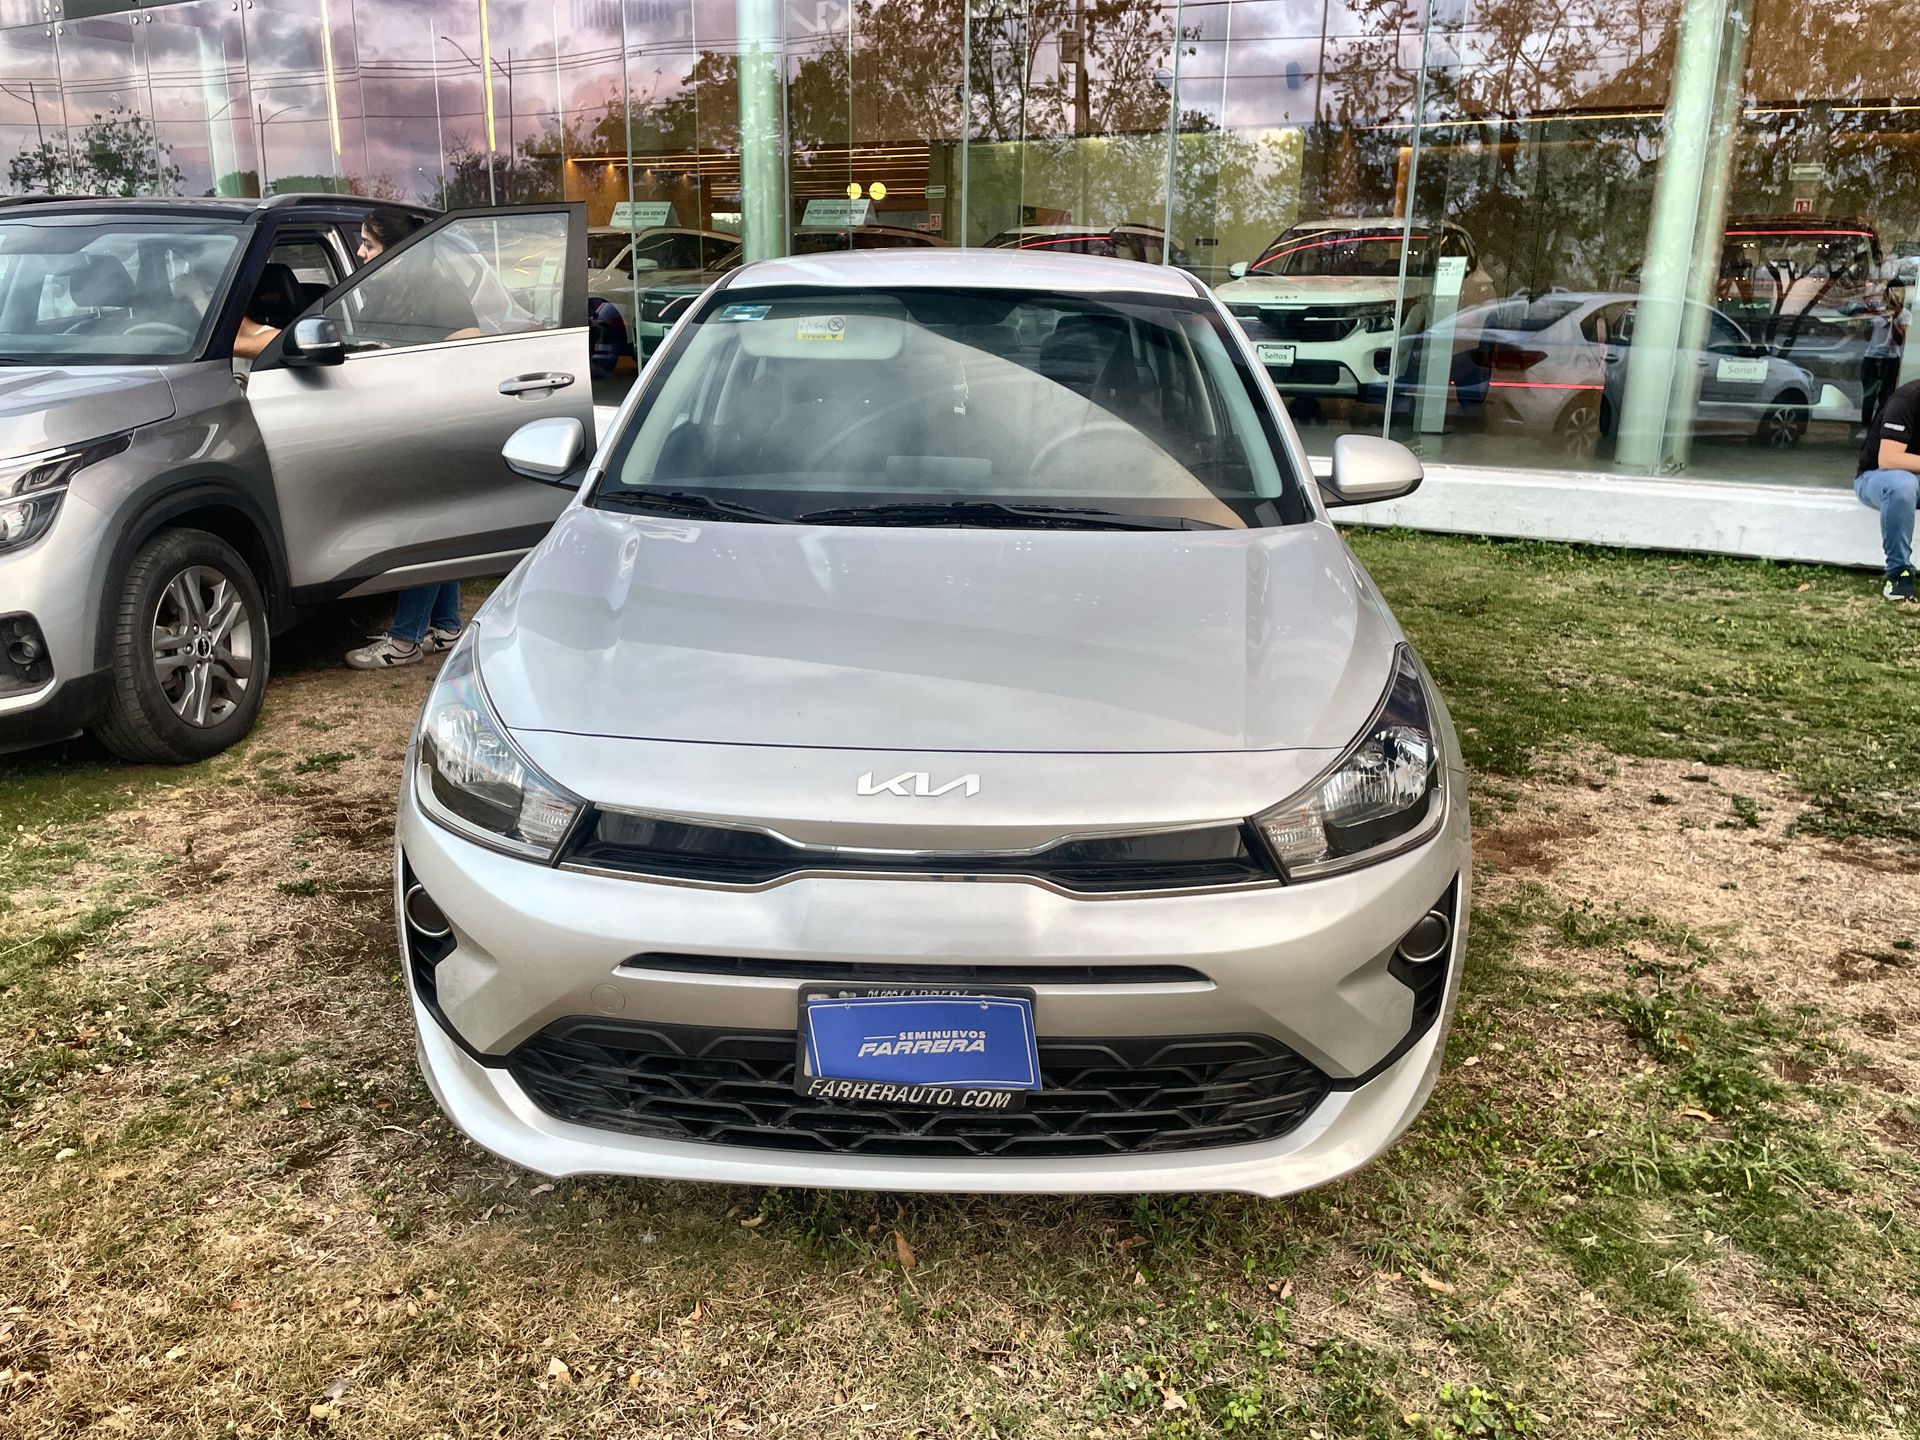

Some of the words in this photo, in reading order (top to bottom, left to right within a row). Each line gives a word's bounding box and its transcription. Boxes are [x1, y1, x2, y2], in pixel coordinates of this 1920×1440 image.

[1264, 351, 1288, 360] Seltos
[1727, 364, 1758, 374] Sonet
[856, 771, 981, 798] KIA
[899, 1030, 986, 1040] SEMINUEVOS
[857, 1039, 985, 1057] FARRERA
[807, 1078, 1012, 1109] FARRERAUTO.COM
